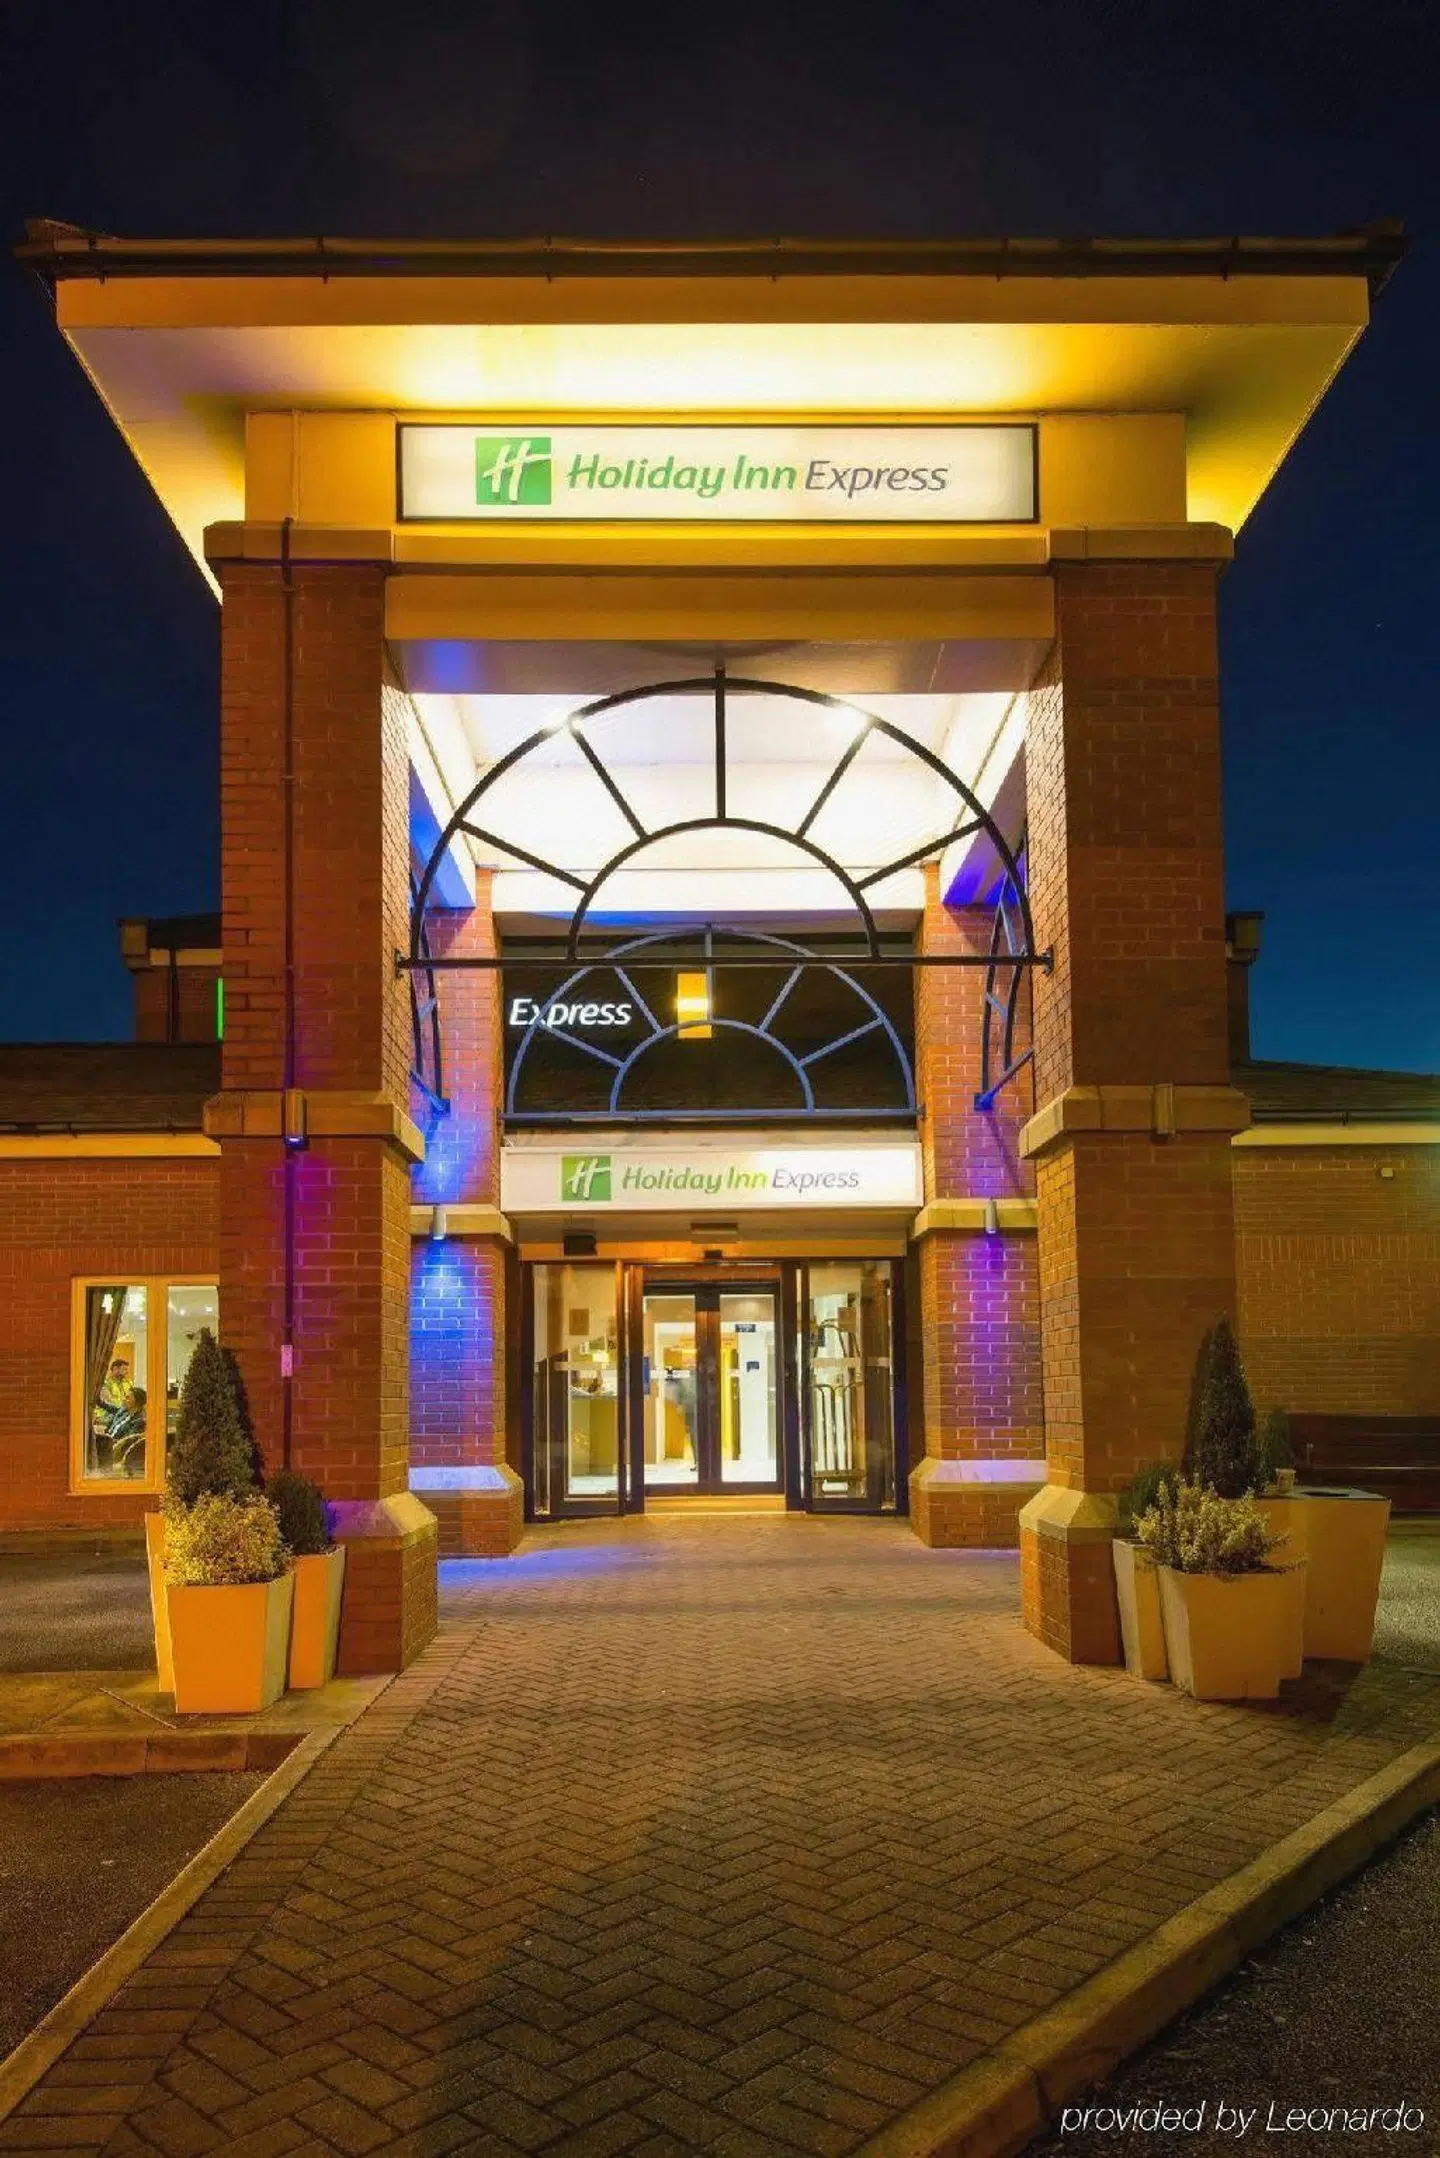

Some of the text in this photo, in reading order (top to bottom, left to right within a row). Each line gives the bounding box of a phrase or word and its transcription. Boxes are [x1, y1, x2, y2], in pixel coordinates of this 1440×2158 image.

[567, 453, 726, 498] Holiday
[733, 454, 798, 490] Inn
[805, 460, 949, 499] Express
[509, 998, 632, 1029] Express
[622, 1166, 723, 1194] Holiday
[727, 1166, 768, 1189] Inn
[772, 1168, 860, 1194] Express
